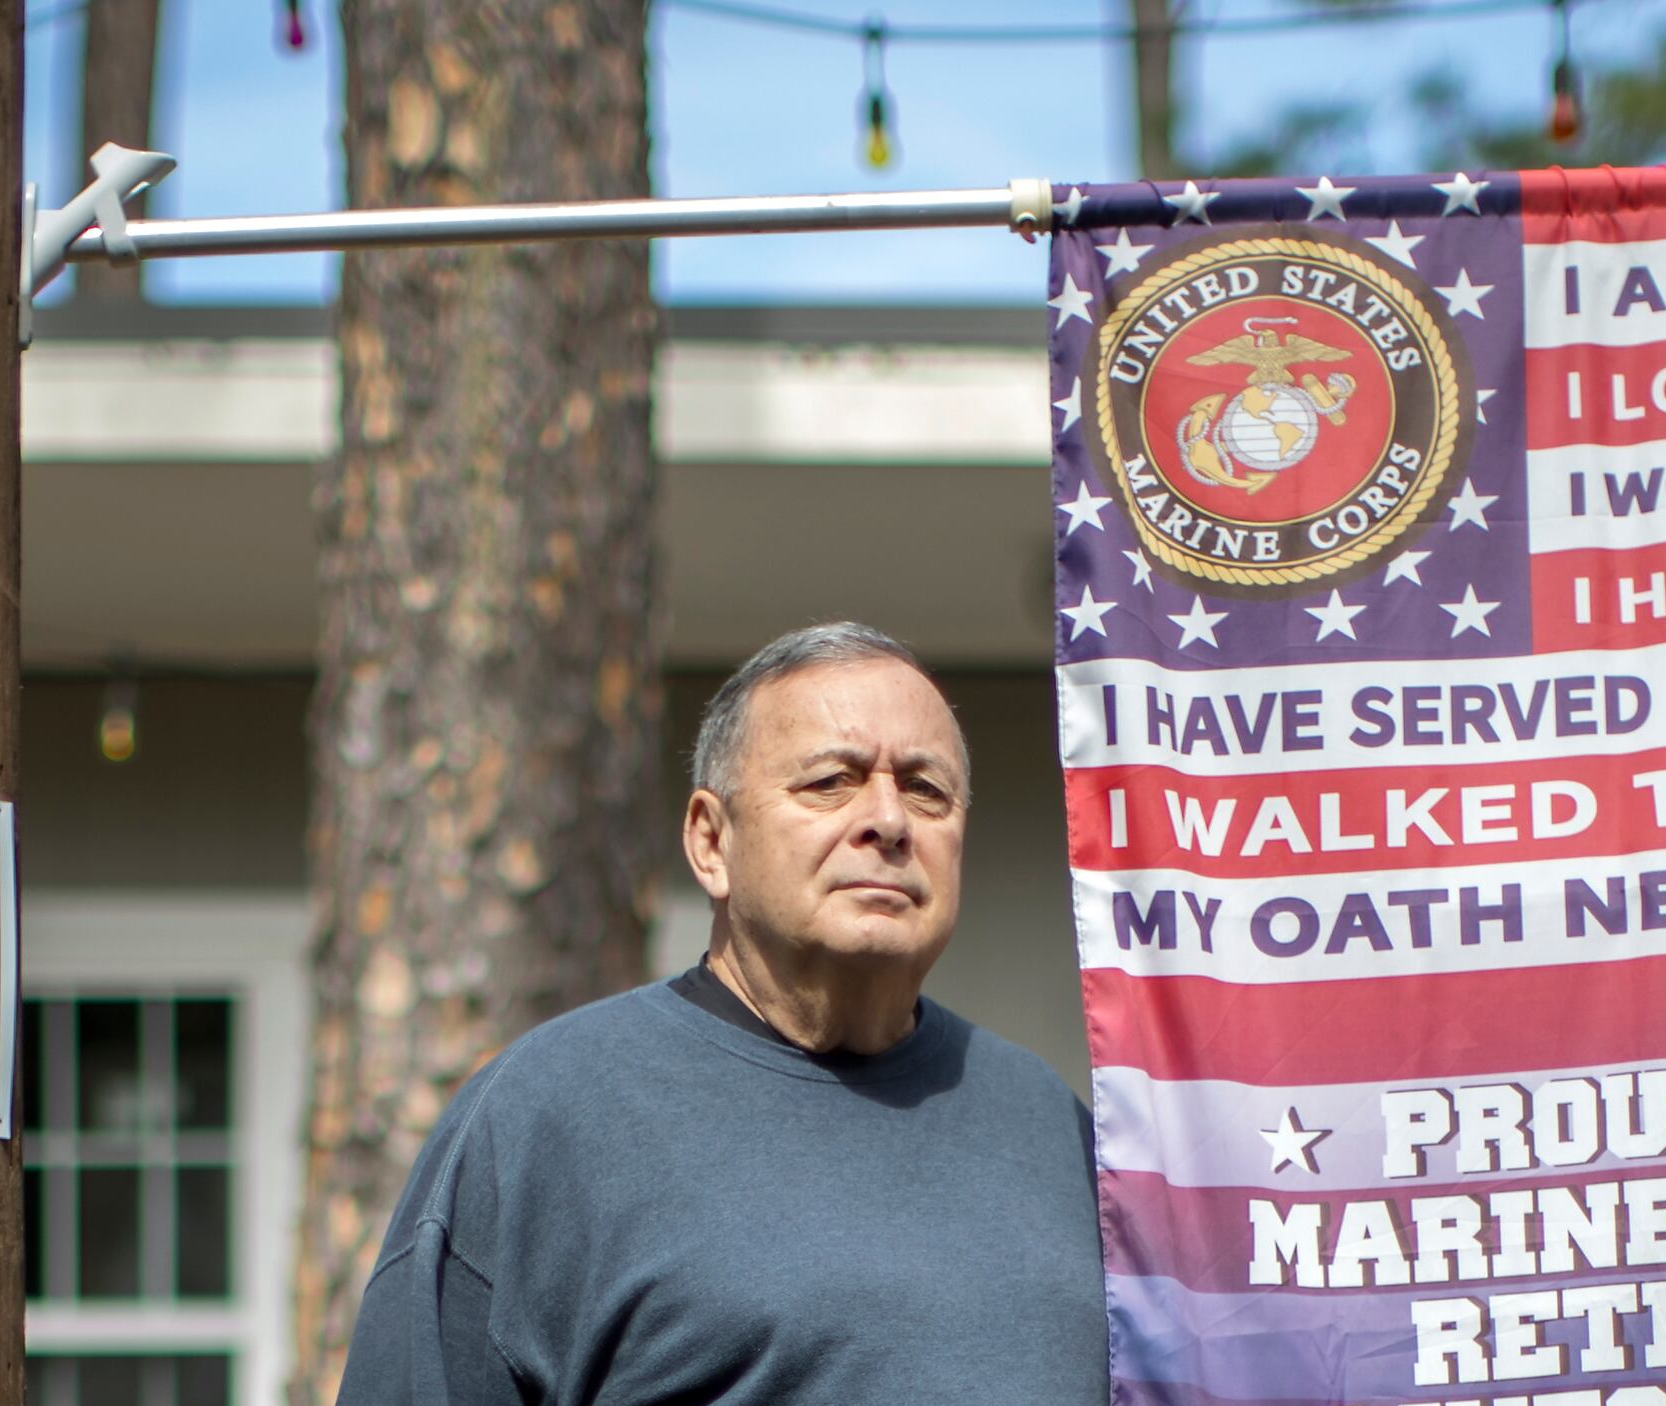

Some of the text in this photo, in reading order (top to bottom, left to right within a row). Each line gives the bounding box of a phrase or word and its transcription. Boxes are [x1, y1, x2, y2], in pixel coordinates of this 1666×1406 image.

[1110, 265, 1421, 386] UNITED STATES
[1564, 265, 1579, 315] I
[1567, 371, 1582, 419] I
[1124, 442, 1421, 561] MARINE CORPS
[1569, 471, 1586, 517] I
[1574, 576, 1590, 624] I
[1104, 683, 1118, 746] I
[1147, 684, 1325, 757] HAVE
[1348, 674, 1652, 747] SERVED
[1110, 785, 1127, 848] I
[1163, 779, 1599, 858] WALKED
[1112, 887, 1221, 956] MY
[1249, 883, 1522, 959] OATH
